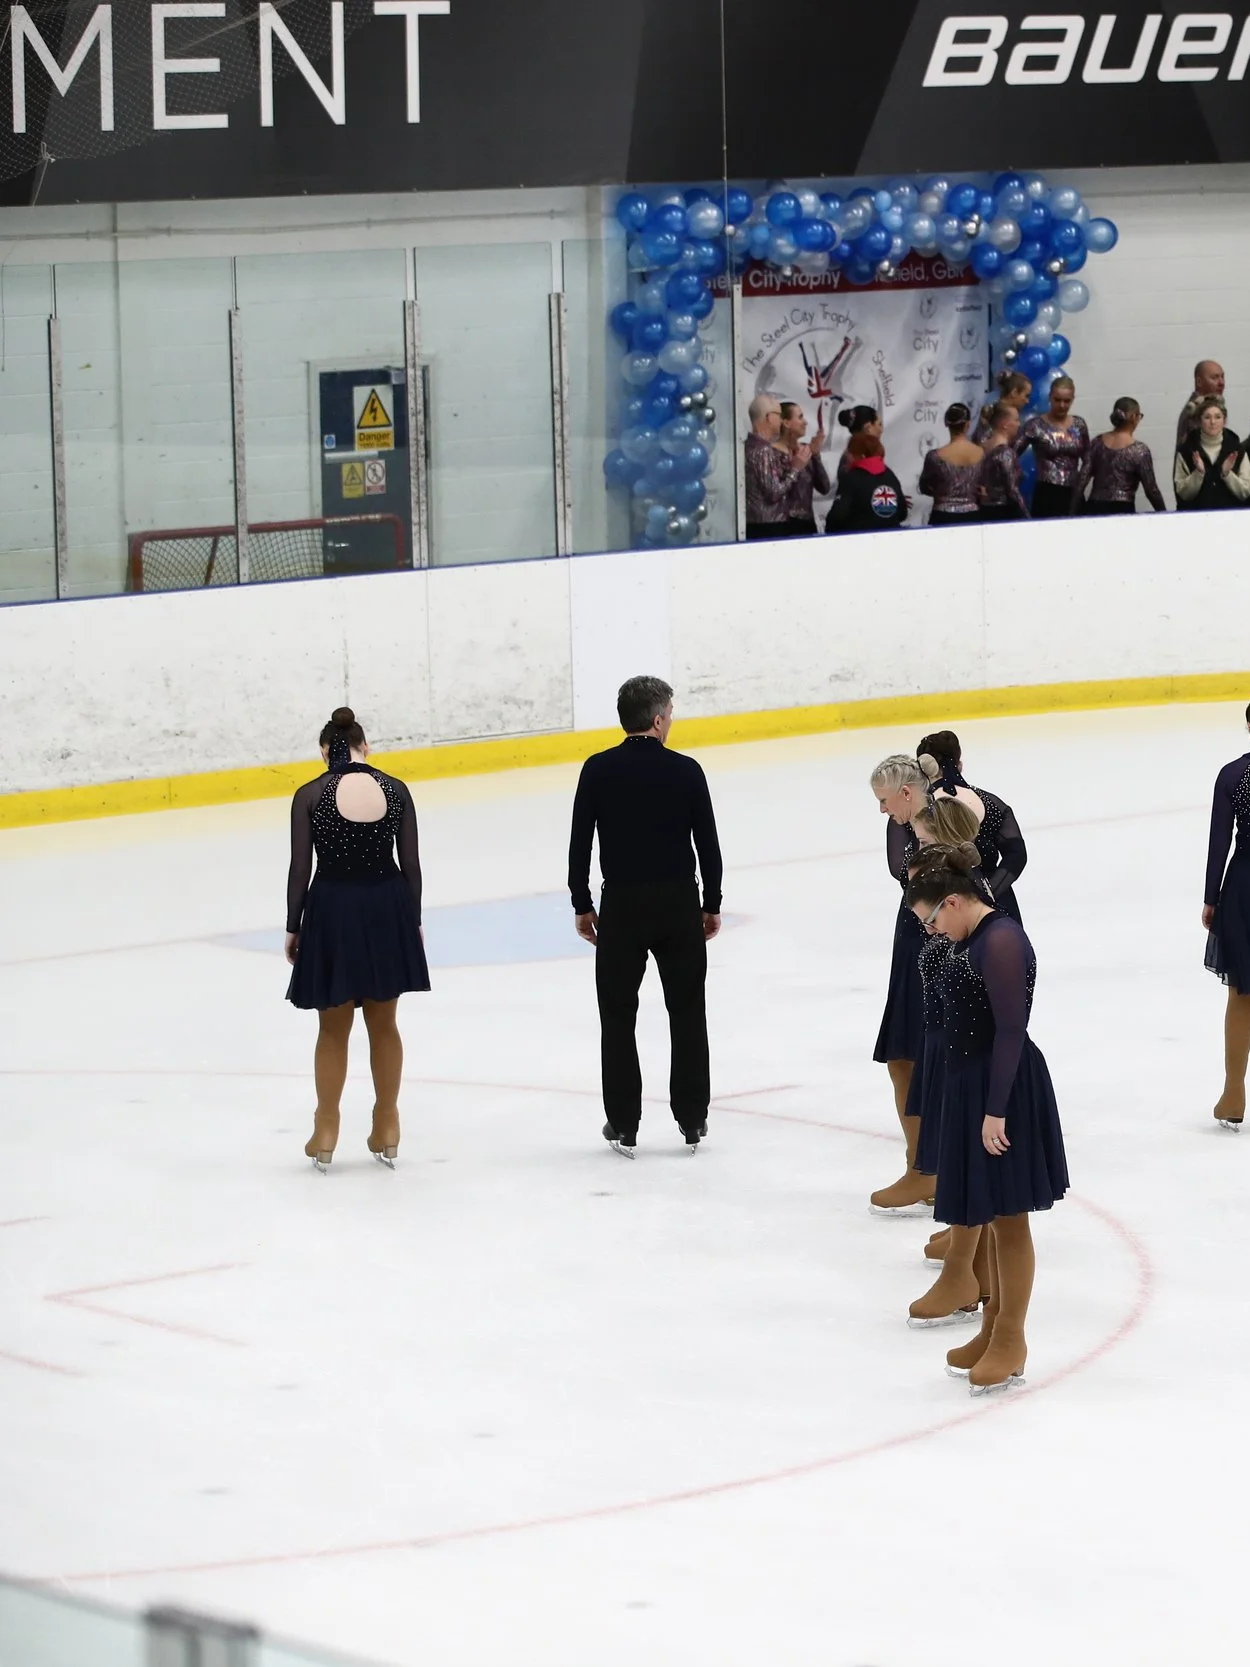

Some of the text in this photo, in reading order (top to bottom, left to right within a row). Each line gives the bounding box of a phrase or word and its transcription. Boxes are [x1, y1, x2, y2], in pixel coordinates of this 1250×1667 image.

[10, 0, 451, 134] MENT
[749, 269, 783, 291] City
[787, 270, 842, 290] rophy
[742, 302, 859, 374] The Steel City Trophy
[913, 336, 939, 353] City
[913, 408, 939, 425] City
[359, 431, 391, 442] Danger
